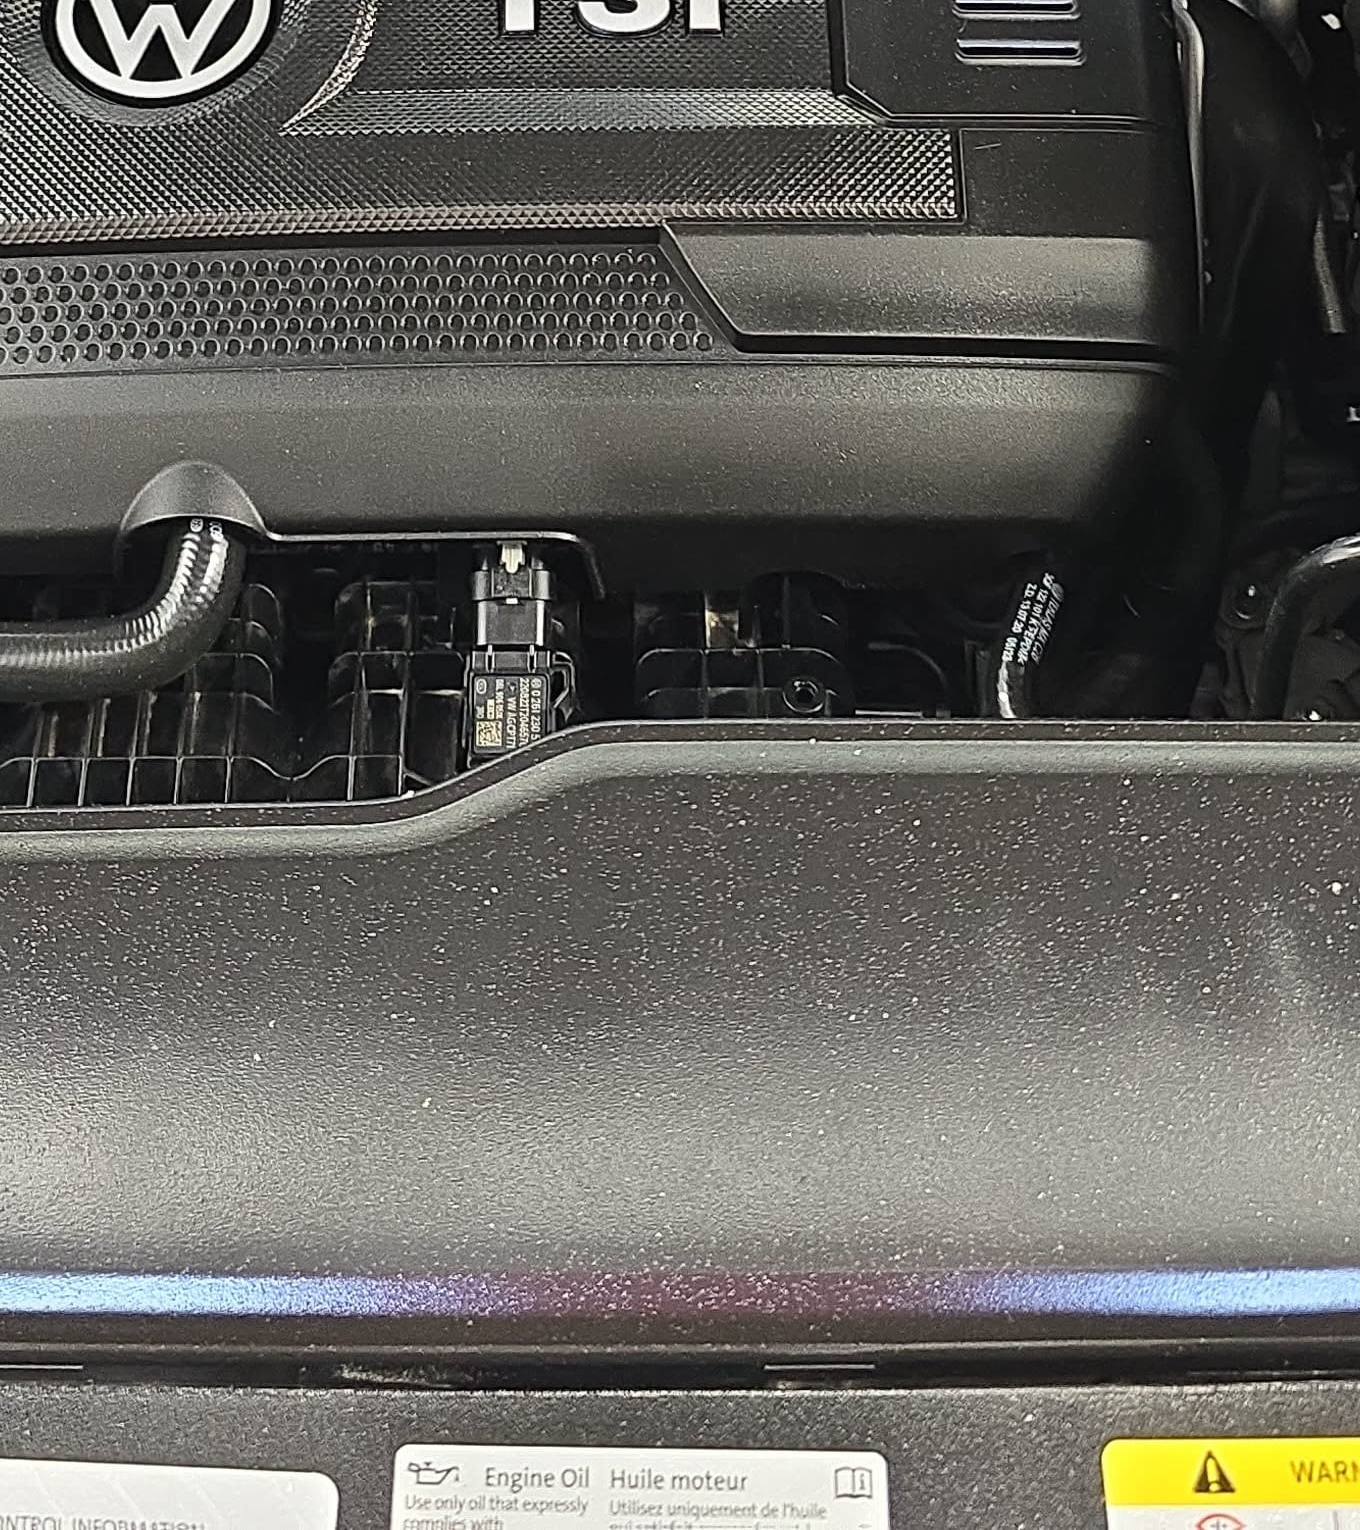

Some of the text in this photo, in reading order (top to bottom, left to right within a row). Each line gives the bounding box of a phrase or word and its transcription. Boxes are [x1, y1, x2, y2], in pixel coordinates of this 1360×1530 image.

[485, 1467, 589, 1493] Engine Oil
[610, 1469, 748, 1492] Huile moteur
[405, 1496, 589, 1517] Use only oil that expressly
[609, 1500, 827, 1523] Utilisez uniquement de l'huile
